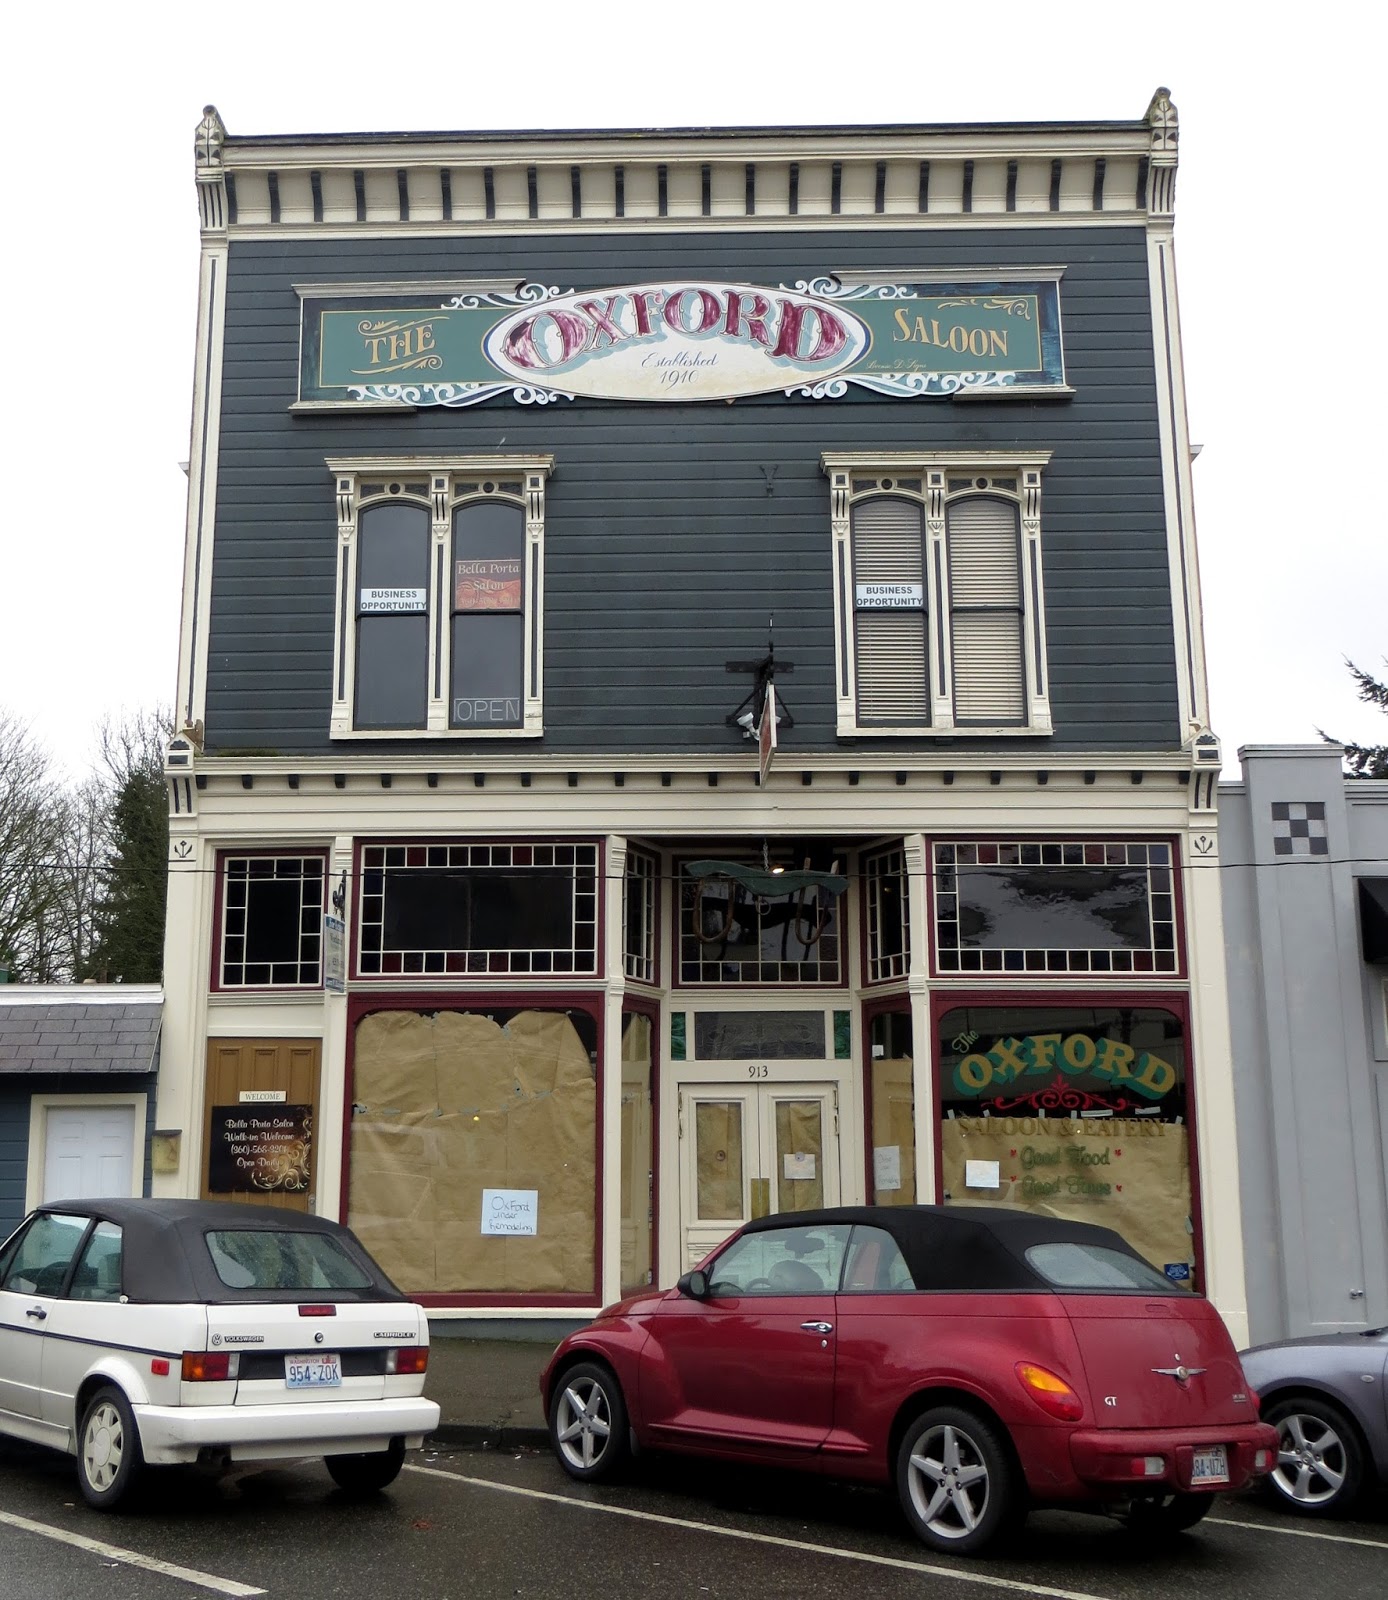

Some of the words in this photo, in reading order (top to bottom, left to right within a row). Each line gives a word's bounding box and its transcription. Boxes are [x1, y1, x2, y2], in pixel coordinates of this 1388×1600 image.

[364, 324, 436, 364] THE
[499, 287, 853, 370] OXFORD
[893, 308, 1009, 358] SALOON
[641, 351, 719, 368] Established
[660, 369, 699, 391] 1910
[458, 563, 487, 574] Bella
[490, 563, 520, 574] Porta
[473, 579, 505, 590] Salon
[371, 590, 417, 598] BUSINESS
[866, 586, 913, 595] BUSINESS
[361, 601, 427, 610] OPPORTUNITY
[856, 597, 923, 606] OPPORTUNITY
[457, 700, 520, 721] OPEN
[952, 1030, 979, 1053] The
[748, 1065, 768, 1078] 913
[953, 1033, 1176, 1100] OXFORD
[245, 1093, 281, 1101] WELCOME
[224, 1119, 248, 1129] Bella
[272, 1118, 294, 1128] Salon
[958, 1116, 1051, 1136] SALOON
[1083, 1117, 1169, 1137] EATERY
[236, 1157, 255, 1169] Open
[1020, 1146, 1061, 1169] Good
[224, 1335, 265, 1343] VOLKSWAGEN
[1104, 1396, 1117, 1406] GT
